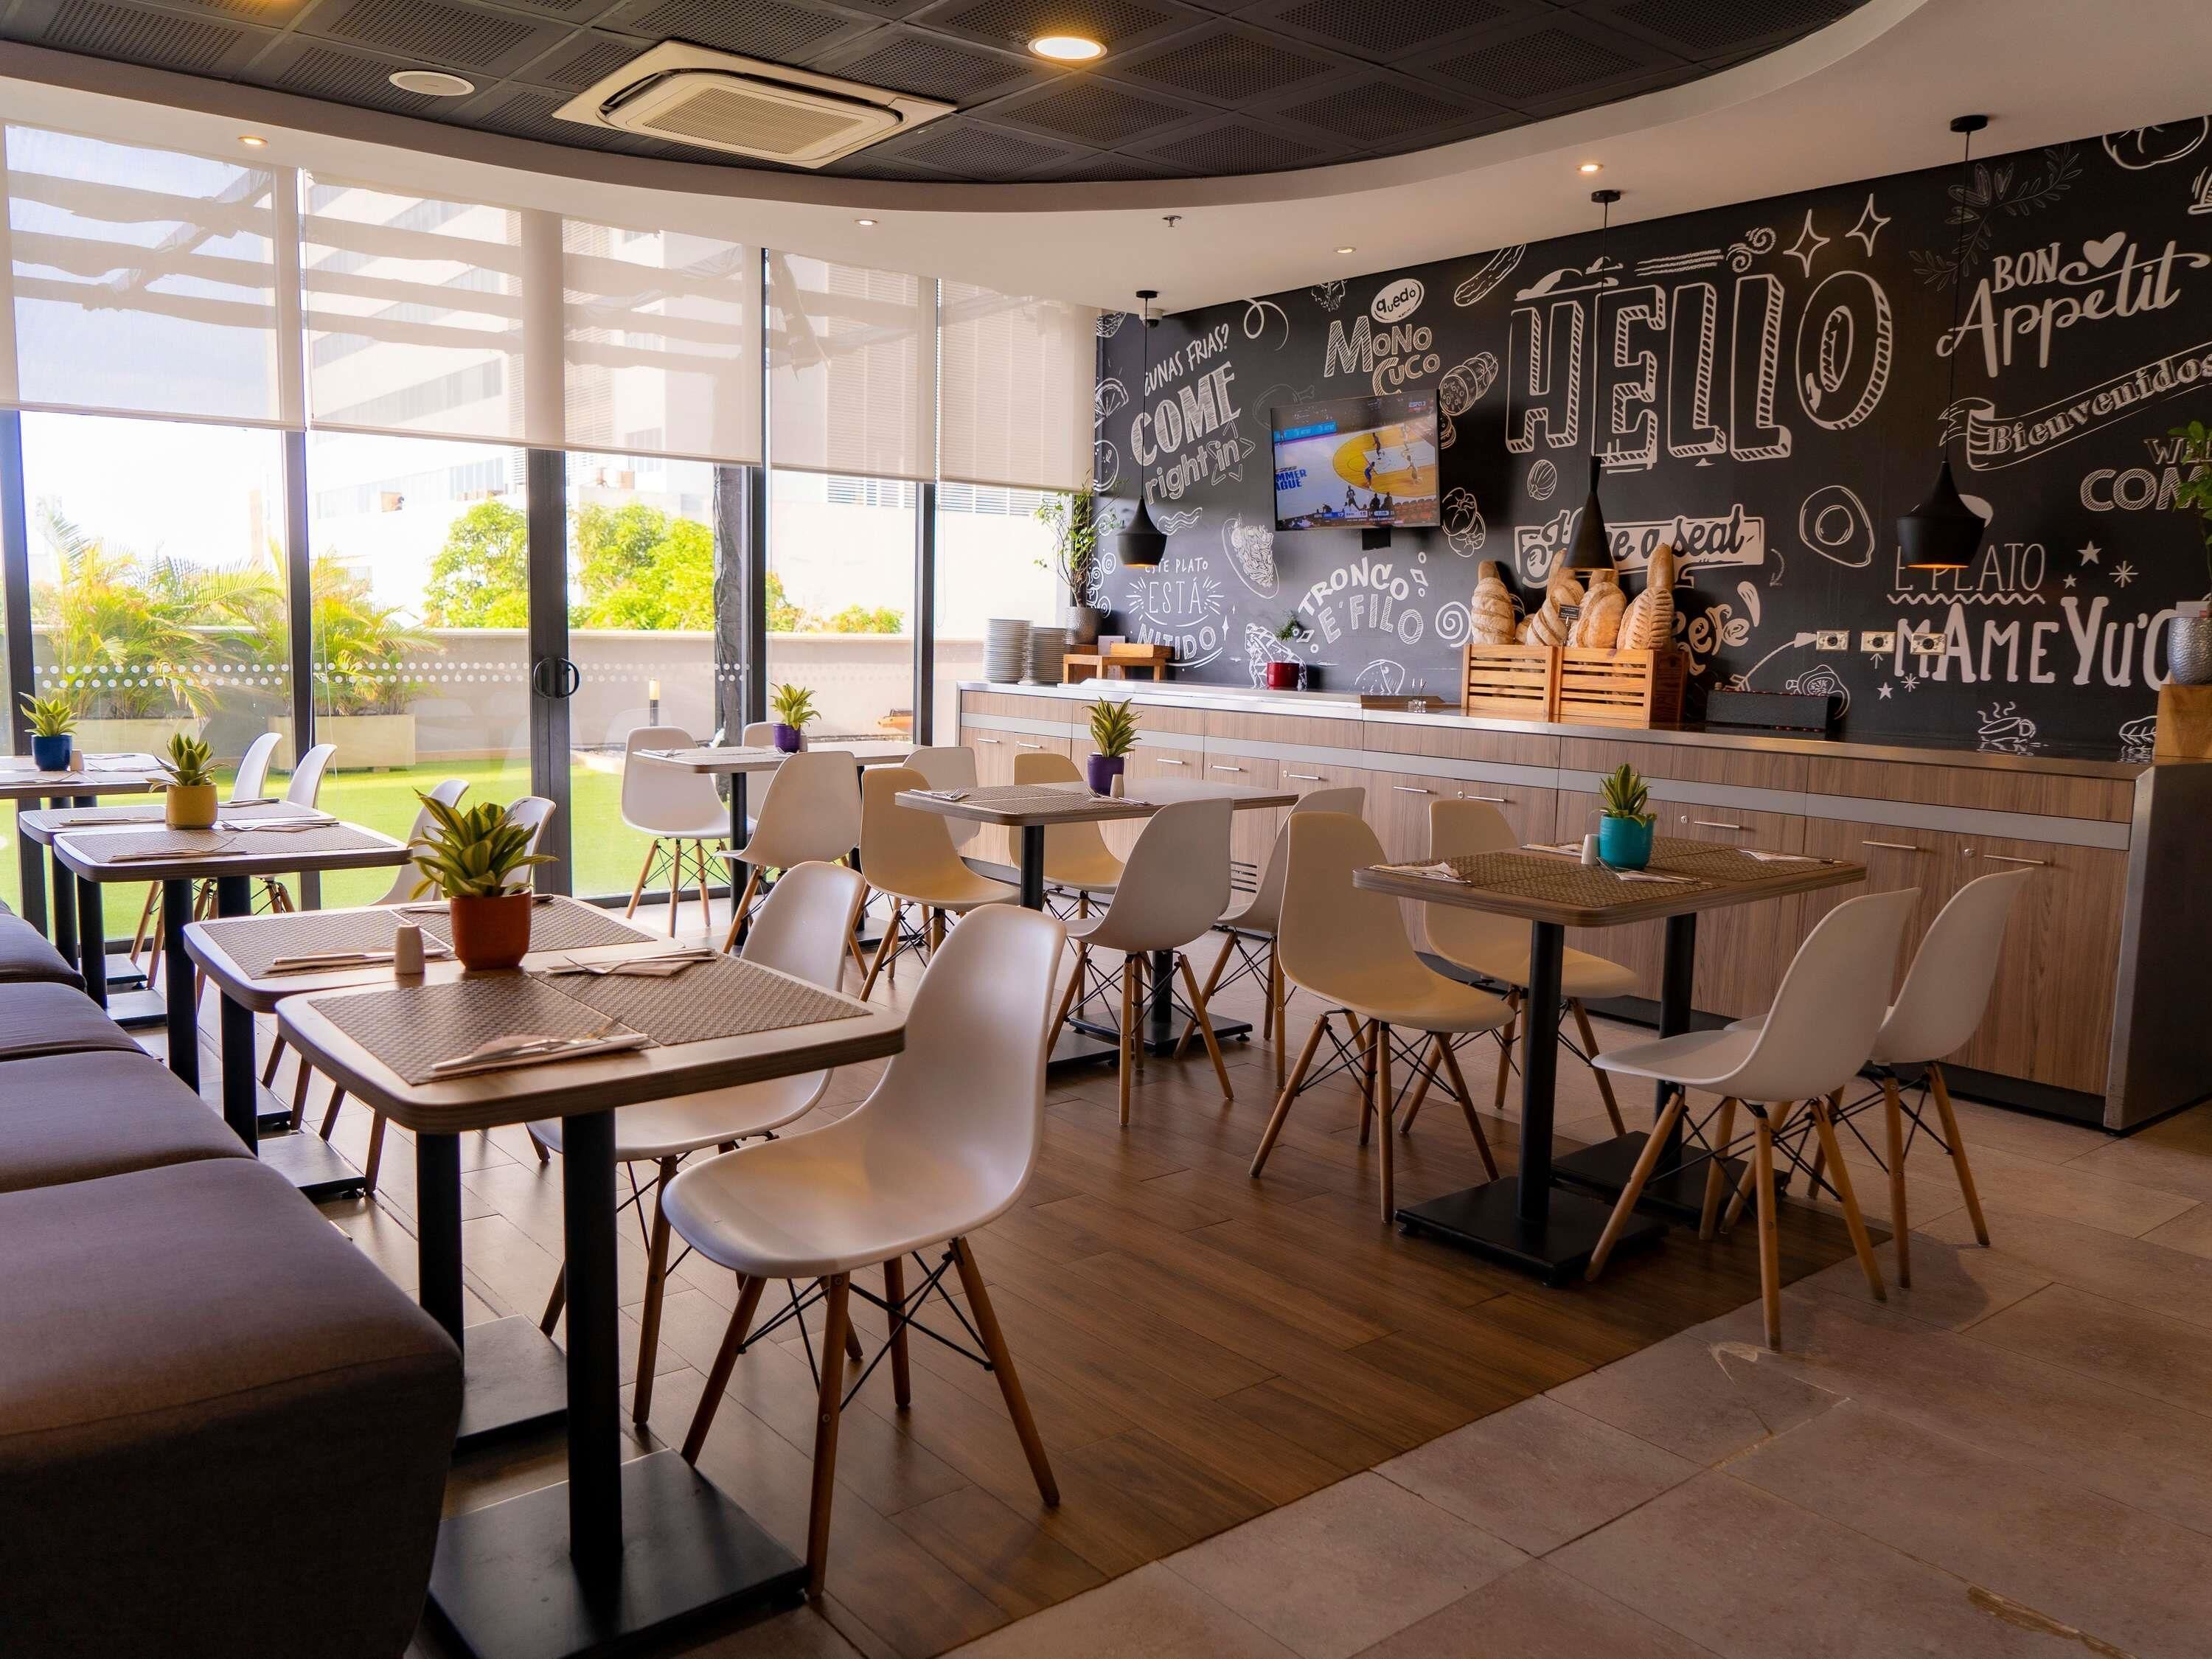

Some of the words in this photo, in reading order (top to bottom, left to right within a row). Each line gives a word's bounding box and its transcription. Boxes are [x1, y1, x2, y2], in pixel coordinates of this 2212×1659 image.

[1992, 242, 2062, 293] BON
[1935, 240, 2211, 378] Appetit
[1186, 323, 1229, 372] FRIAS?
[1506, 271, 1893, 470] HELLO
[1130, 361, 1242, 467] COME
[1986, 353, 2212, 455] Bienvenidos
[1145, 445, 1208, 505] right
[1214, 439, 1240, 472] in
[2080, 466, 2212, 512] COM
[1672, 506, 1745, 557] seat
[1175, 557, 1208, 574] PLATO
[1298, 557, 1409, 616] TRONCO
[1149, 577, 1203, 614] ESTÁ
